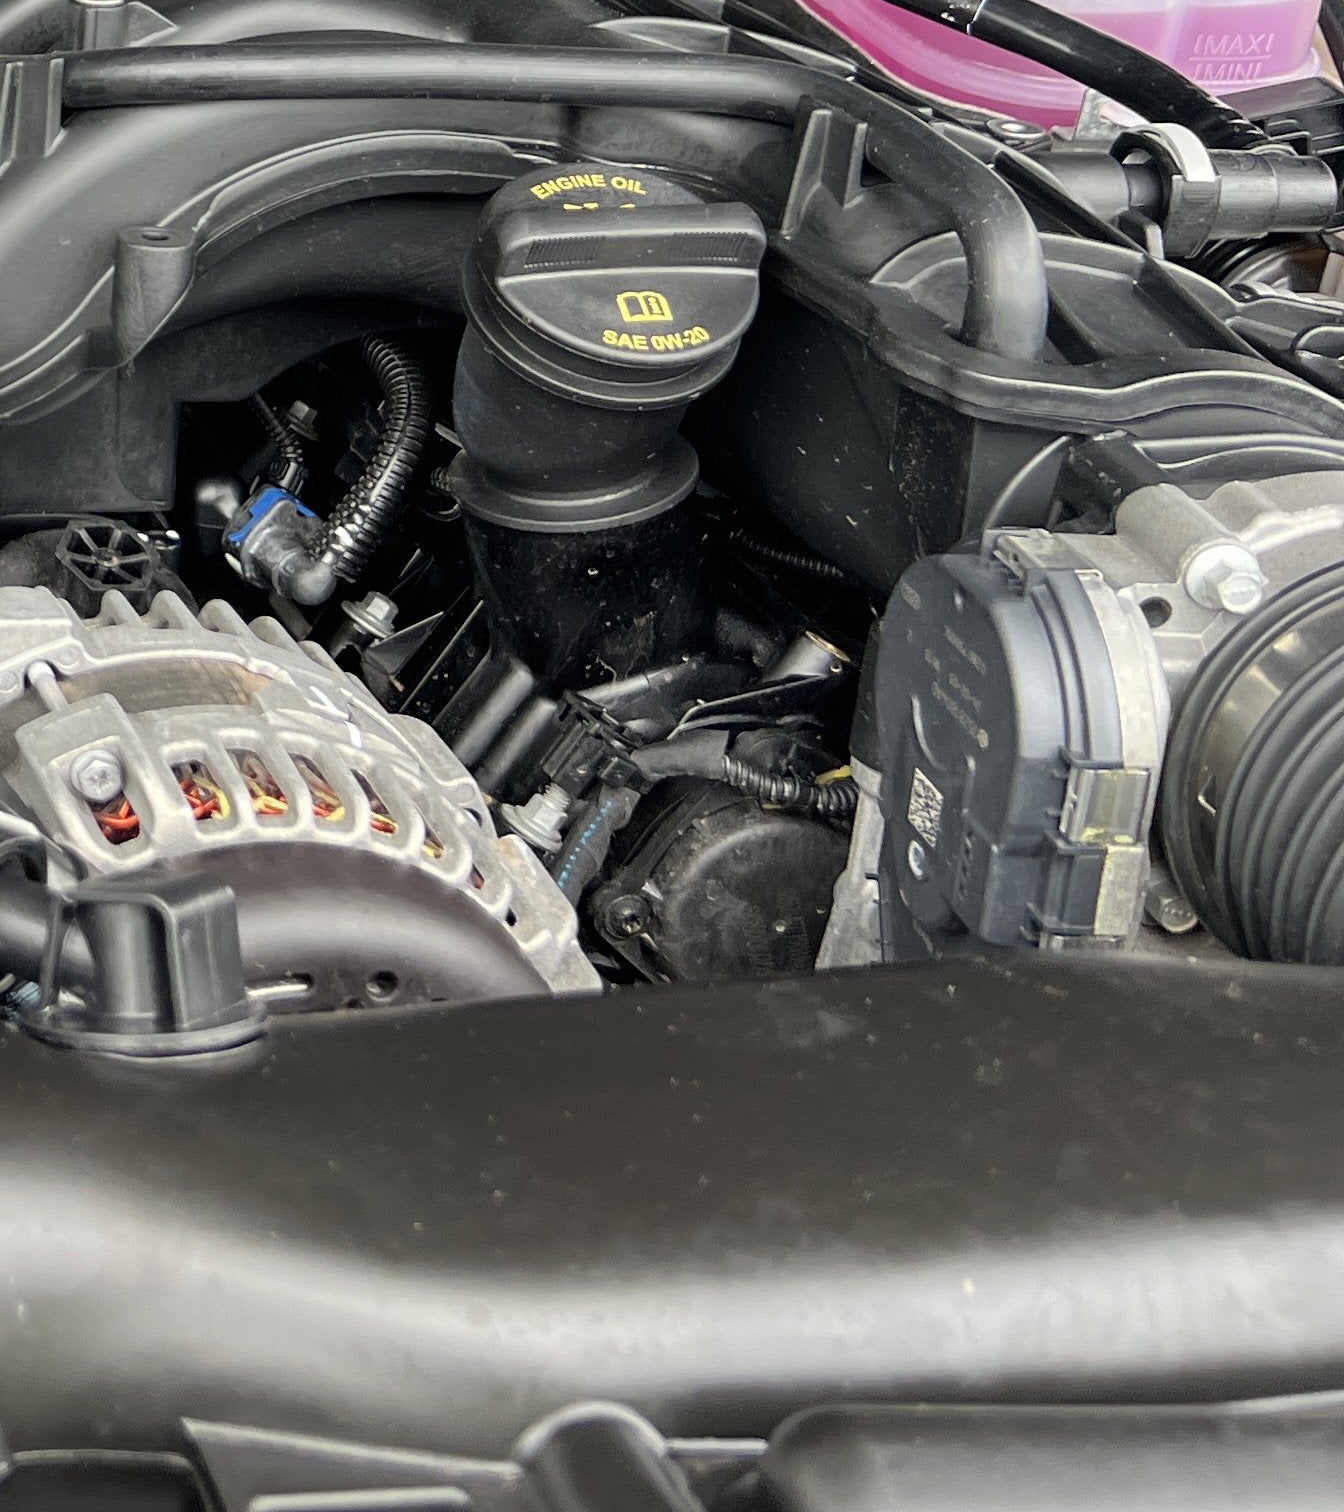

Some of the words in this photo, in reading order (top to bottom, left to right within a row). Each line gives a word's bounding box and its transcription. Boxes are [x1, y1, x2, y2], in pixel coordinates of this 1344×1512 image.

[530, 173, 607, 201] ENGINE
[612, 176, 648, 196] OIL
[602, 328, 649, 351] SAE
[651, 325, 711, 352] 0W-20
